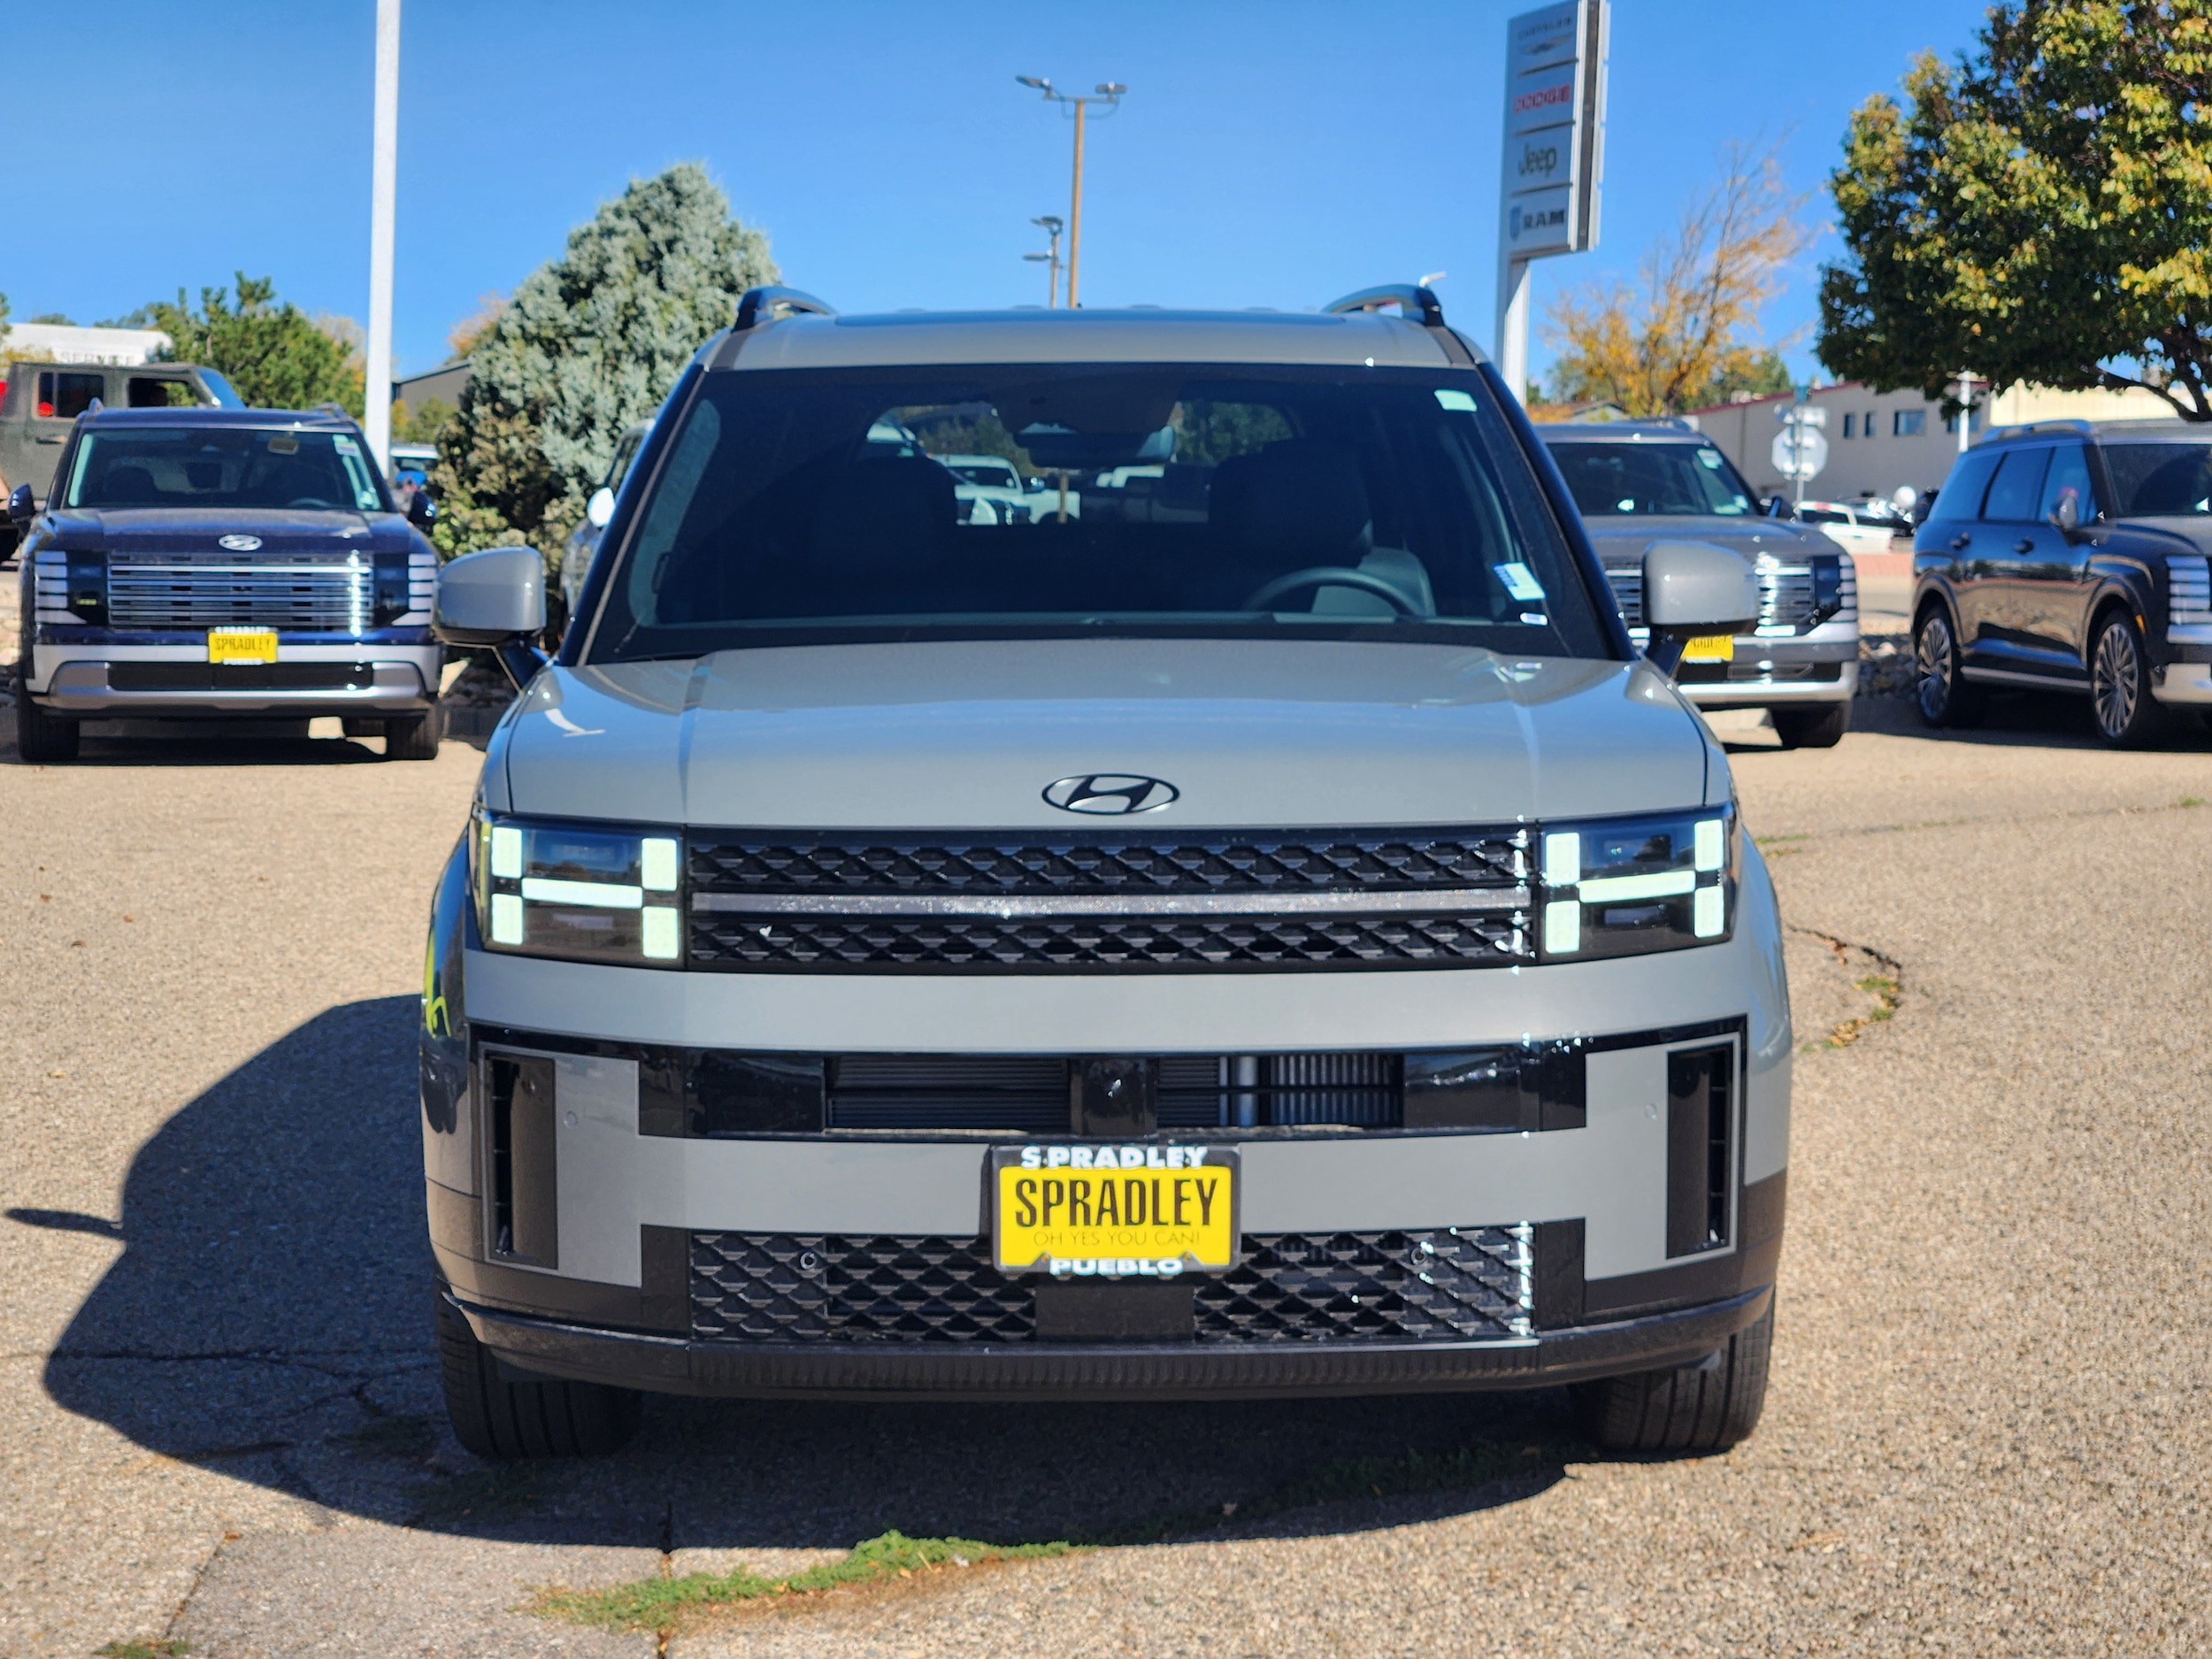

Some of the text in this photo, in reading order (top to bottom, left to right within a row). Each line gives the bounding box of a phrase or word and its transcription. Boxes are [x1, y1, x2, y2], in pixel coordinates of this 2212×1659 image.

[1514, 83, 1571, 115] DODGE
[1518, 142, 1557, 179] Jeep
[1524, 209, 1565, 230] RAM
[215, 637, 271, 650] SPRADLEY
[1015, 1179, 1218, 1227] SPRADLEY
[1033, 1231, 1201, 1246] OH YES YOU CAN!
[1049, 1258, 1184, 1276] PUEBLO
